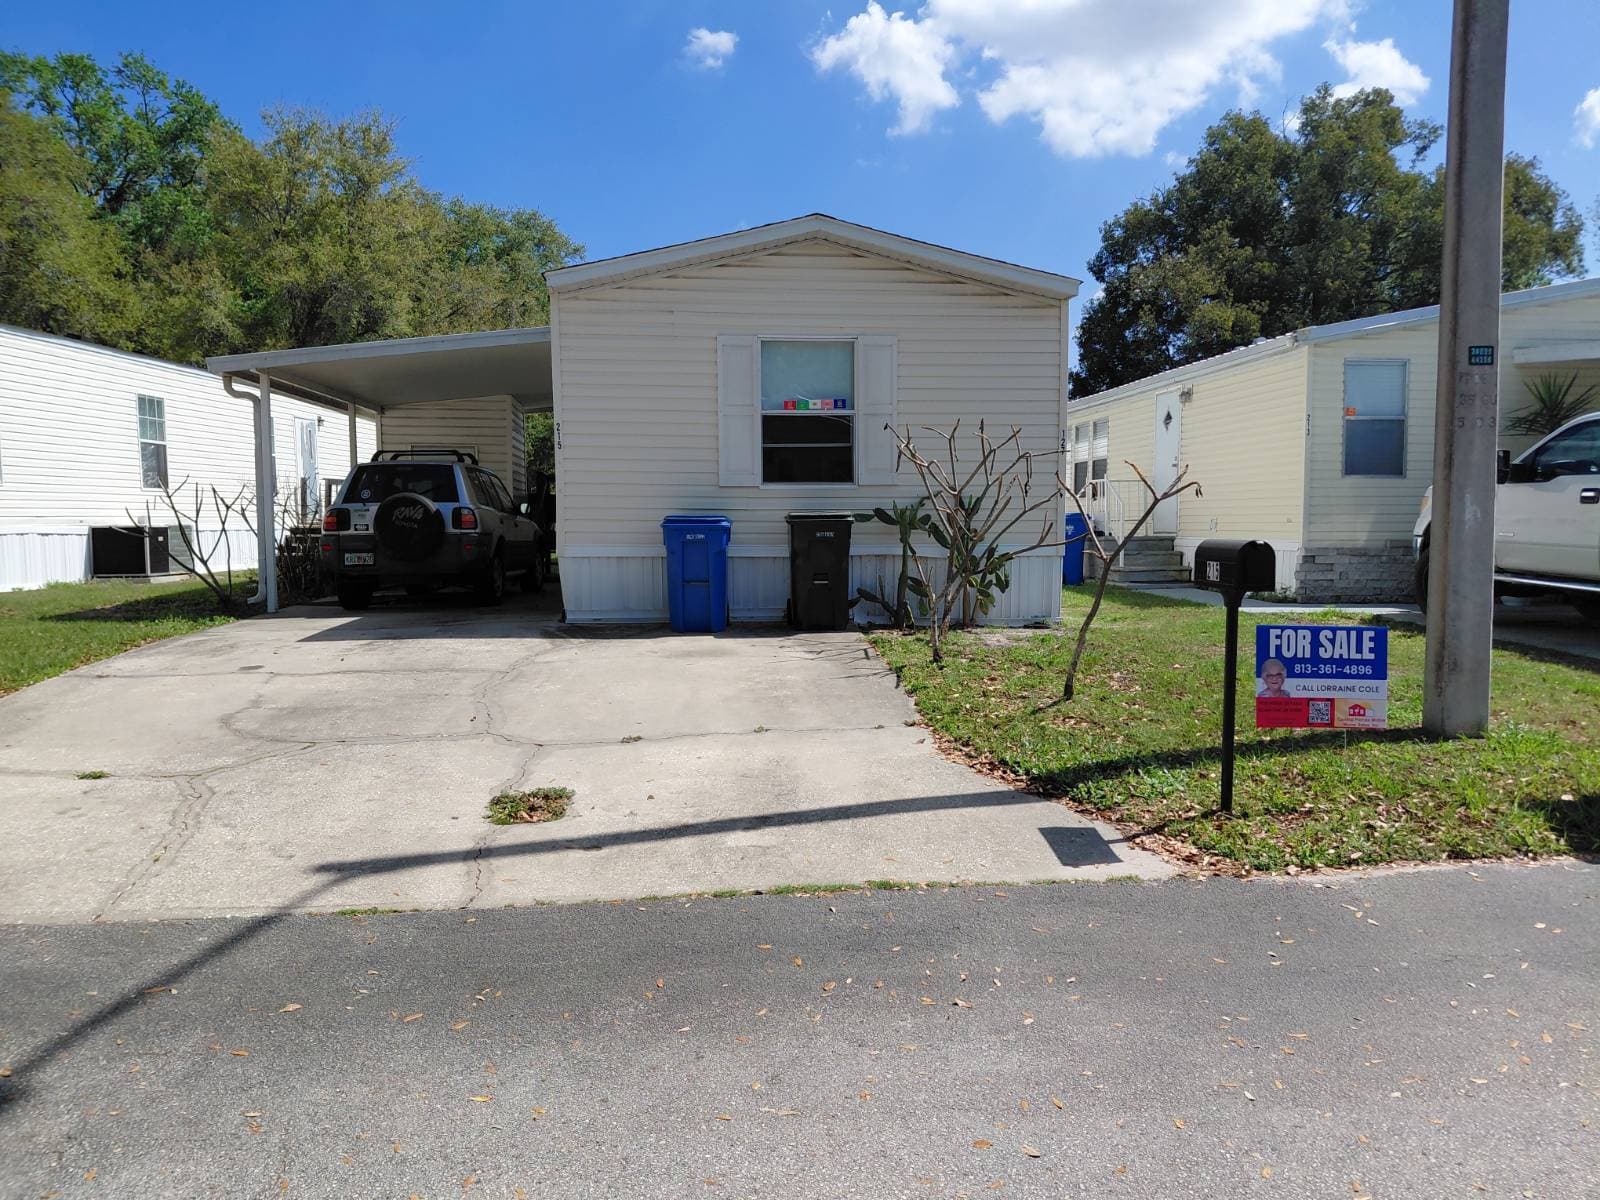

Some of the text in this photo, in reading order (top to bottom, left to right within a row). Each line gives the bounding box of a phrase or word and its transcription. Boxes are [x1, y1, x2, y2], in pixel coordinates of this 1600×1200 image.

[1207, 562, 1220, 580] 215
[1269, 628, 1376, 660] FOR SALE
[1294, 663, 1373, 675] 813-361-4896
[1295, 684, 1379, 693] CALL LORRAINE COLE
